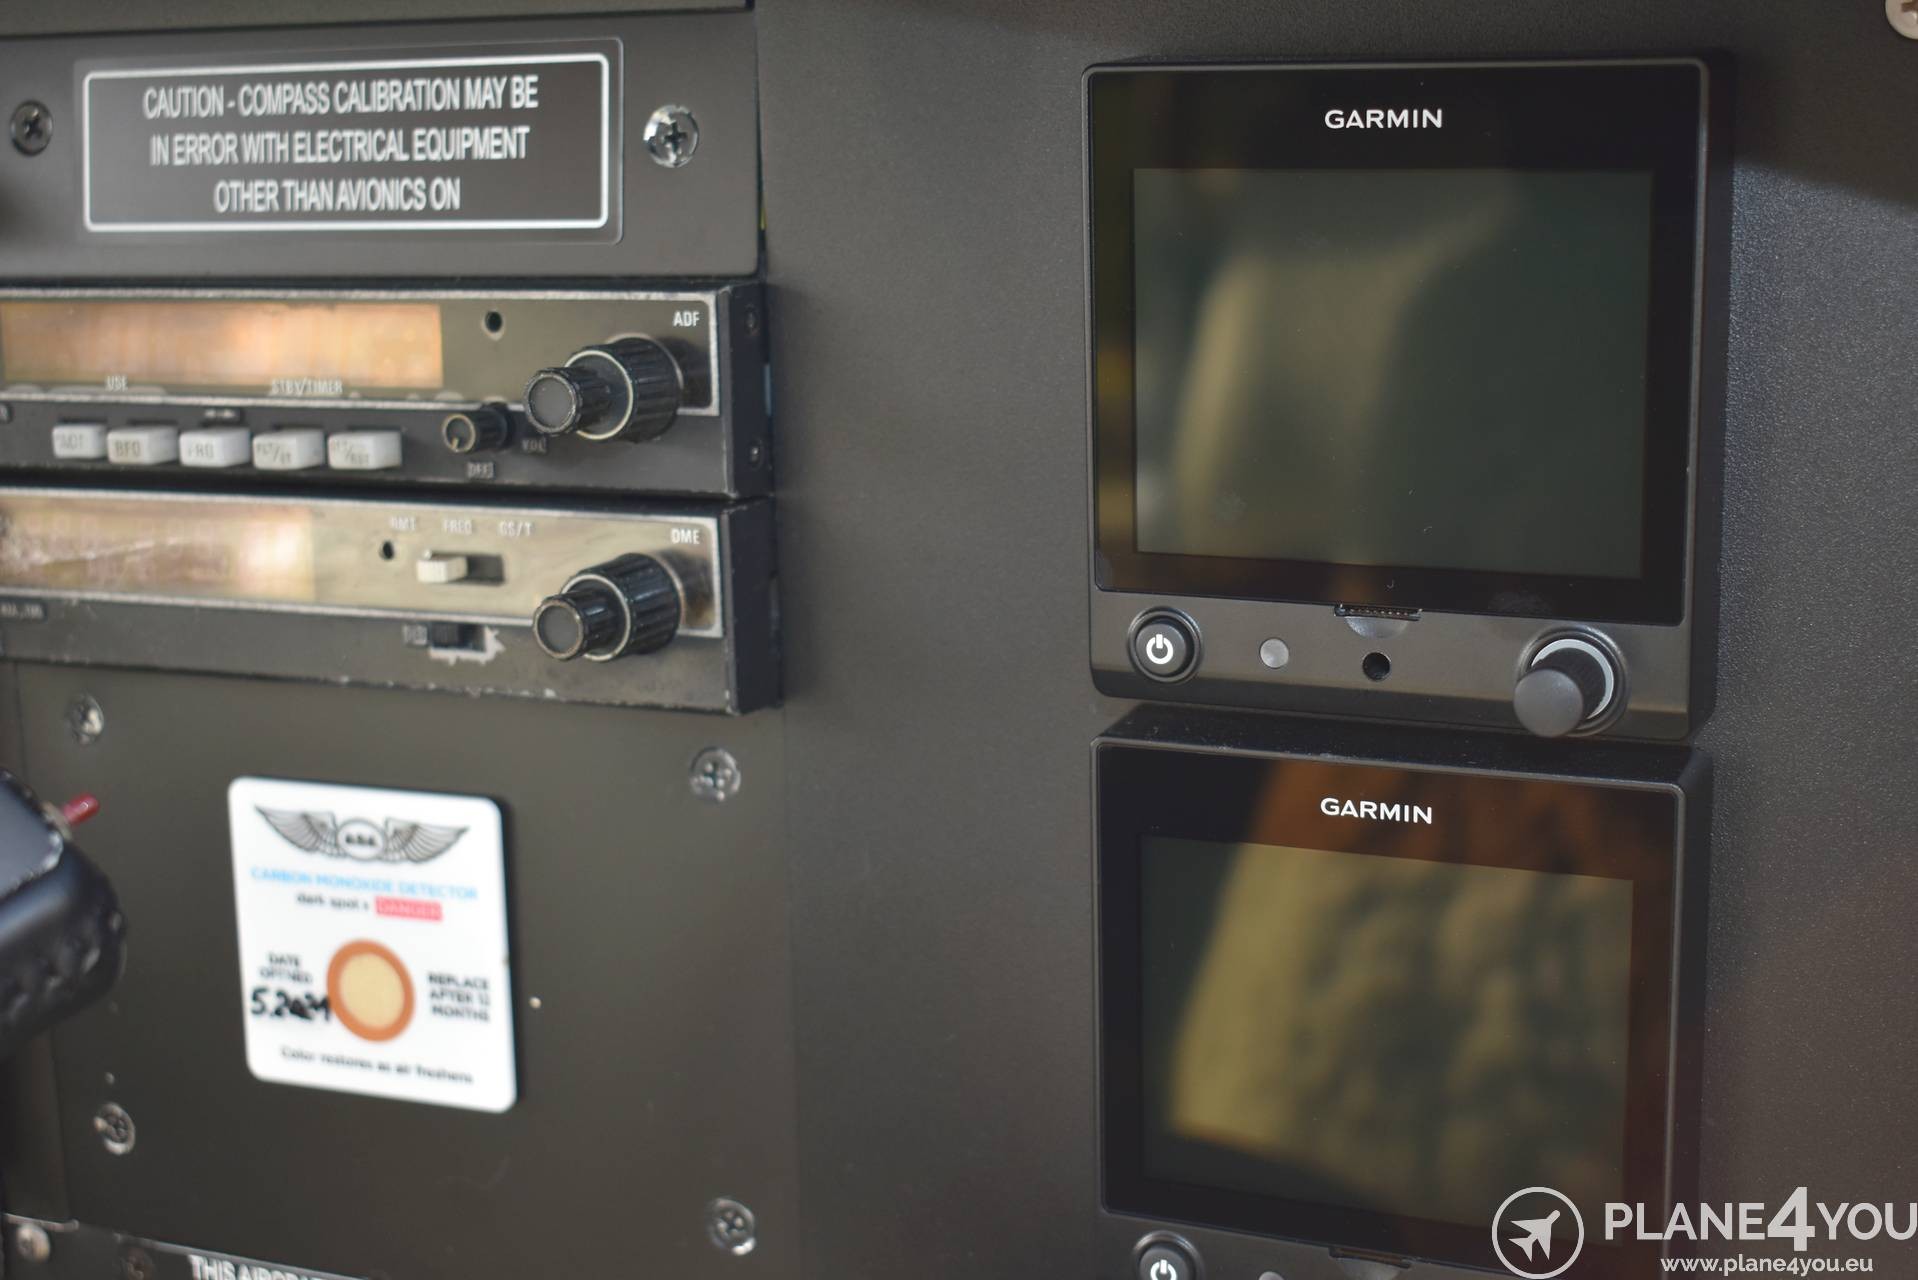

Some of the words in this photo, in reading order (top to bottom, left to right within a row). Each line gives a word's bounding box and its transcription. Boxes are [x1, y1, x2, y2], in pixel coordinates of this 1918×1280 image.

[143, 85, 225, 119] CAUTION
[226, 99, 236, 108] -
[238, 81, 331, 117] COMPASS
[333, 77, 460, 114] CALIBRATION
[464, 75, 507, 109] MAY
[511, 74, 539, 109] BE
[1324, 108, 1443, 129] GARMIN
[151, 133, 170, 166] IN
[173, 131, 239, 166] ERROR
[241, 131, 290, 164] WITH
[292, 126, 410, 163] ELECTRICAL
[412, 125, 530, 161] EQUIPMENT
[213, 179, 280, 213] OTHER
[282, 178, 334, 212] THAN
[336, 177, 427, 211] AVIONICS
[430, 176, 461, 210] ON
[673, 311, 701, 328] ADF
[498, 520, 532, 537] GS/T
[670, 528, 701, 545] DME
[1320, 797, 1432, 824] GARMIN
[250, 866, 312, 885] CARBON
[315, 874, 393, 893] MONOXIDE
[397, 881, 478, 900] DETECTOR
[428, 971, 489, 990] REPLACE
[430, 988, 473, 1004] AFTER
[432, 1004, 490, 1022] MONTHS
[189, 1254, 236, 1280] THIS
